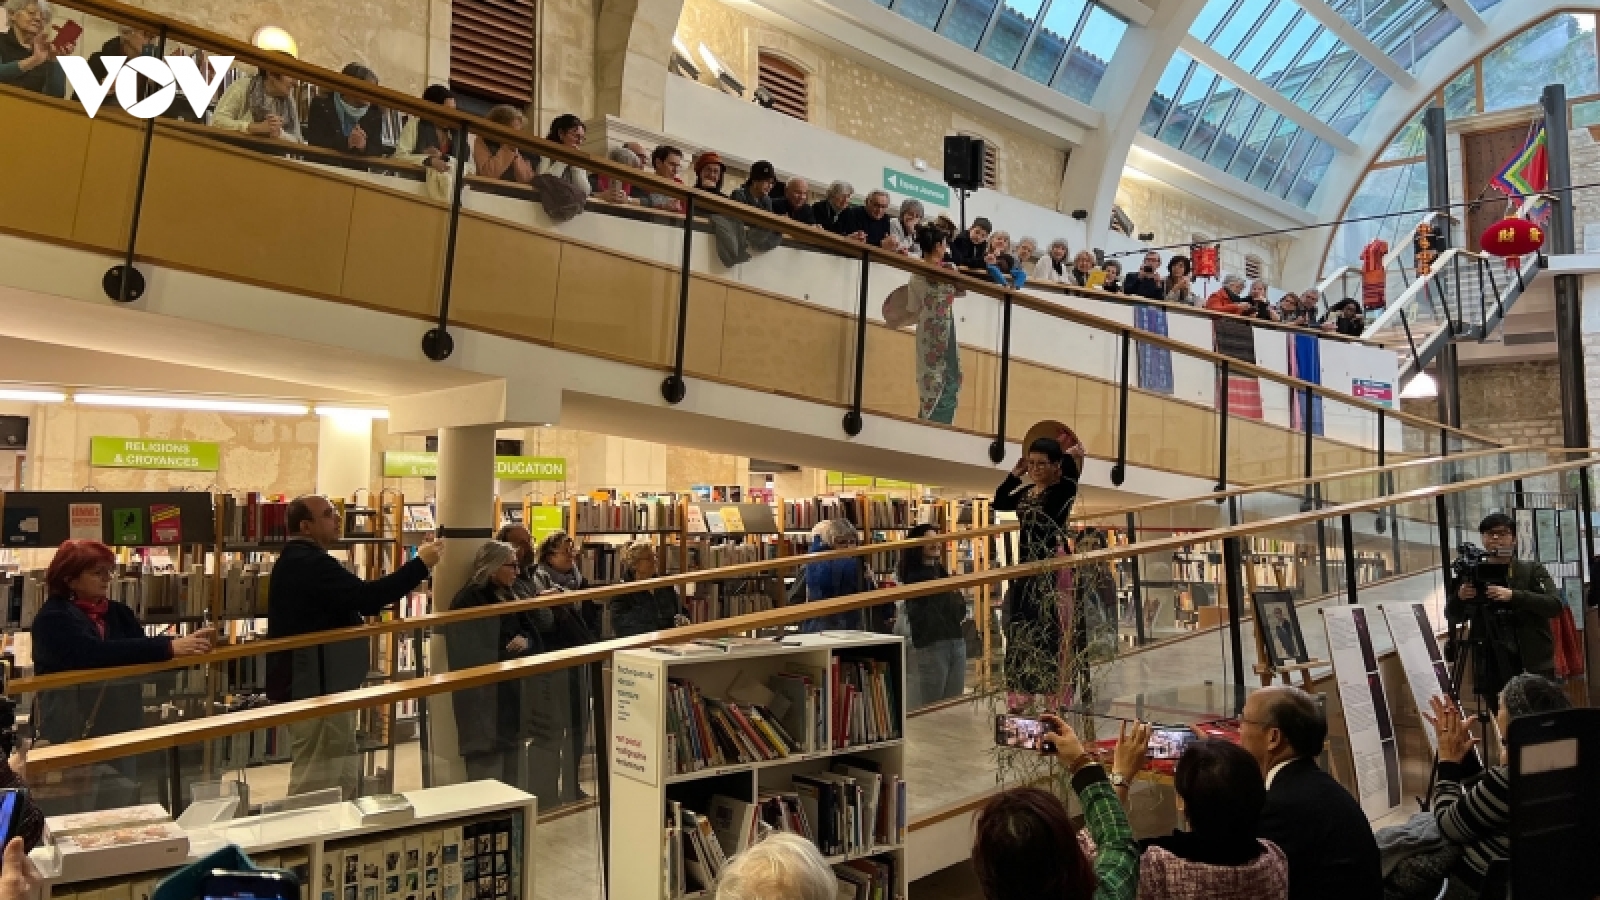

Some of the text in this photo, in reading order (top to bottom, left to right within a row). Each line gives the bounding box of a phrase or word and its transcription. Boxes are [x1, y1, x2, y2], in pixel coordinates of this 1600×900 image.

[125, 441, 190, 454] RELIGIONS
[113, 453, 199, 467] & CROYANCES
